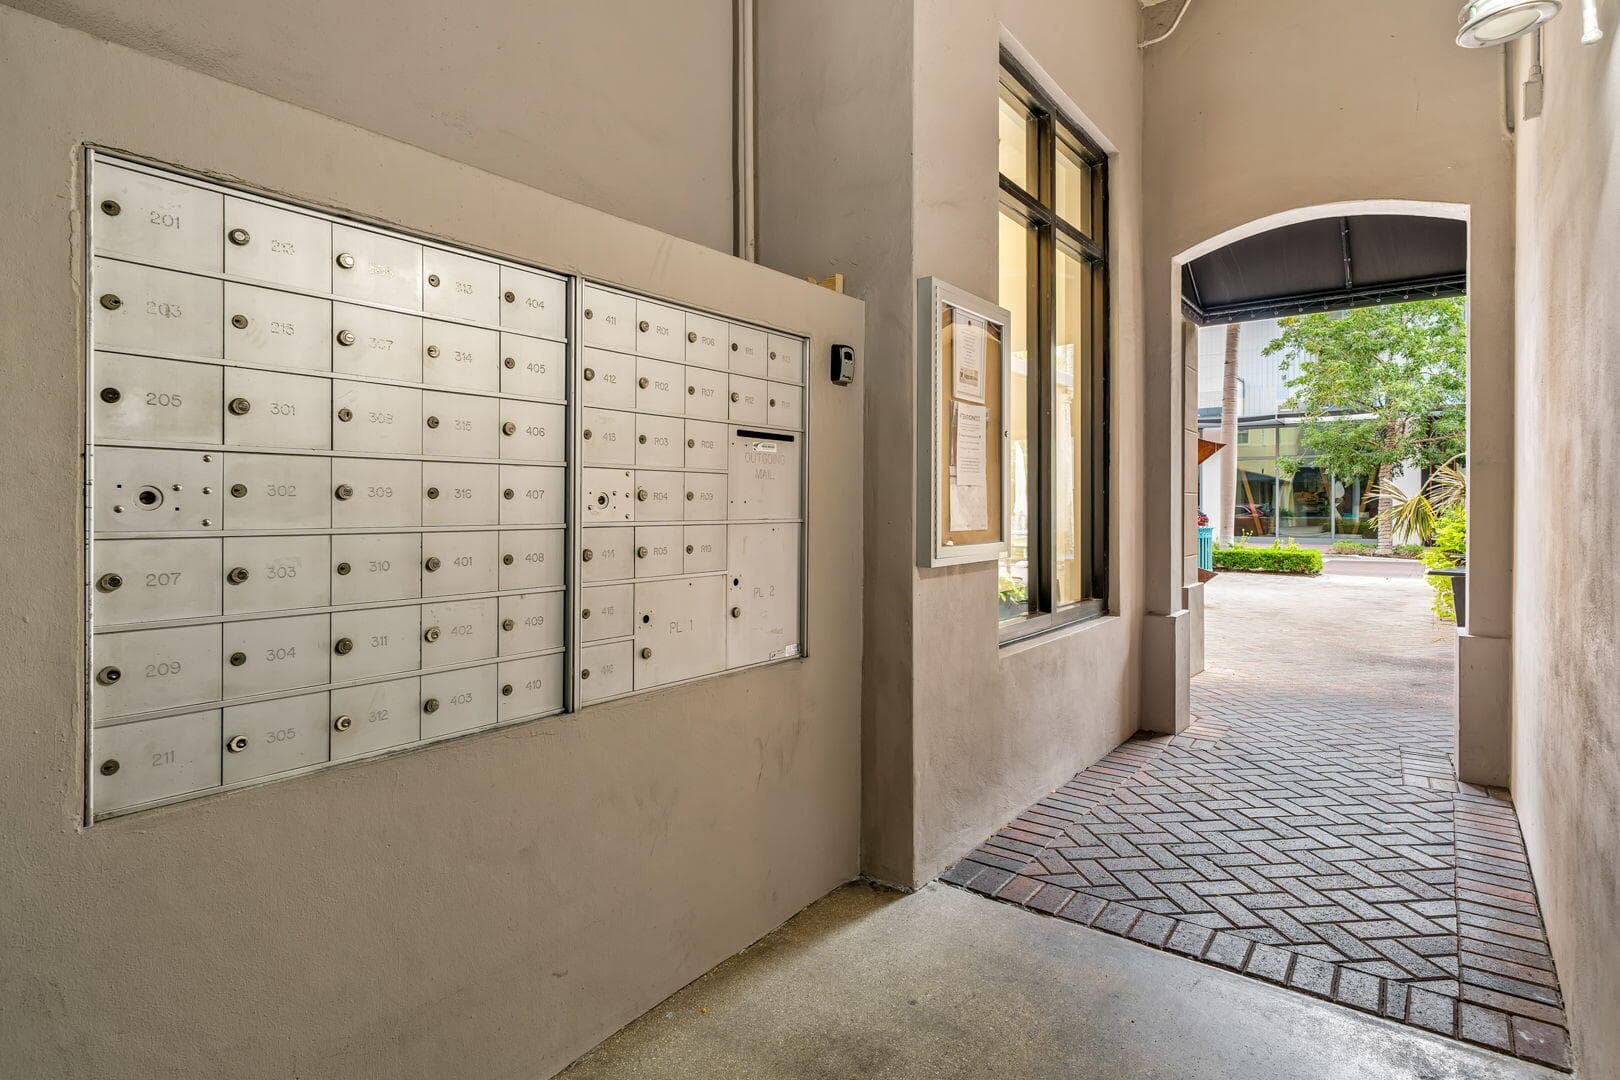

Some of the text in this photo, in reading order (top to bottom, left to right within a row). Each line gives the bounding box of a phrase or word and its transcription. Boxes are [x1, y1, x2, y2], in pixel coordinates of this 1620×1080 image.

[150, 211, 181, 229] 201
[146, 301, 182, 318] 203
[525, 298, 545, 310] 404
[605, 315, 617, 326] 411
[656, 325, 669, 337] R01
[454, 351, 473, 363] 314
[526, 362, 546, 374] 405
[603, 373, 617, 384] 412
[654, 382, 669, 392] R02
[701, 388, 715, 398] R07
[146, 392, 182, 407] 205
[270, 403, 296, 416] 301
[525, 427, 546, 437] 406
[602, 432, 617, 442] 413
[654, 436, 669, 447] R03
[744, 451, 786, 466] OUTGOING
[754, 468, 776, 480] MAIL
[266, 485, 297, 497] 302
[367, 487, 393, 498] 309
[453, 488, 472, 499] 316
[525, 489, 545, 500] 407
[653, 492, 668, 501] R04
[453, 556, 473, 567] 401
[524, 552, 545, 563] 408
[368, 560, 391, 572] 310
[266, 567, 297, 579] 303
[145, 573, 182, 587] 207
[753, 586, 765, 599] PL
[524, 615, 545, 626] 409
[450, 624, 473, 636] 402
[669, 621, 682, 634] PL
[370, 636, 388, 648] 311
[265, 646, 297, 662] 304
[145, 661, 182, 678] 209
[525, 679, 542, 691] 410
[449, 693, 473, 705] 403
[368, 709, 389, 723] 312
[265, 728, 297, 743] 305
[151, 751, 176, 767] 211
